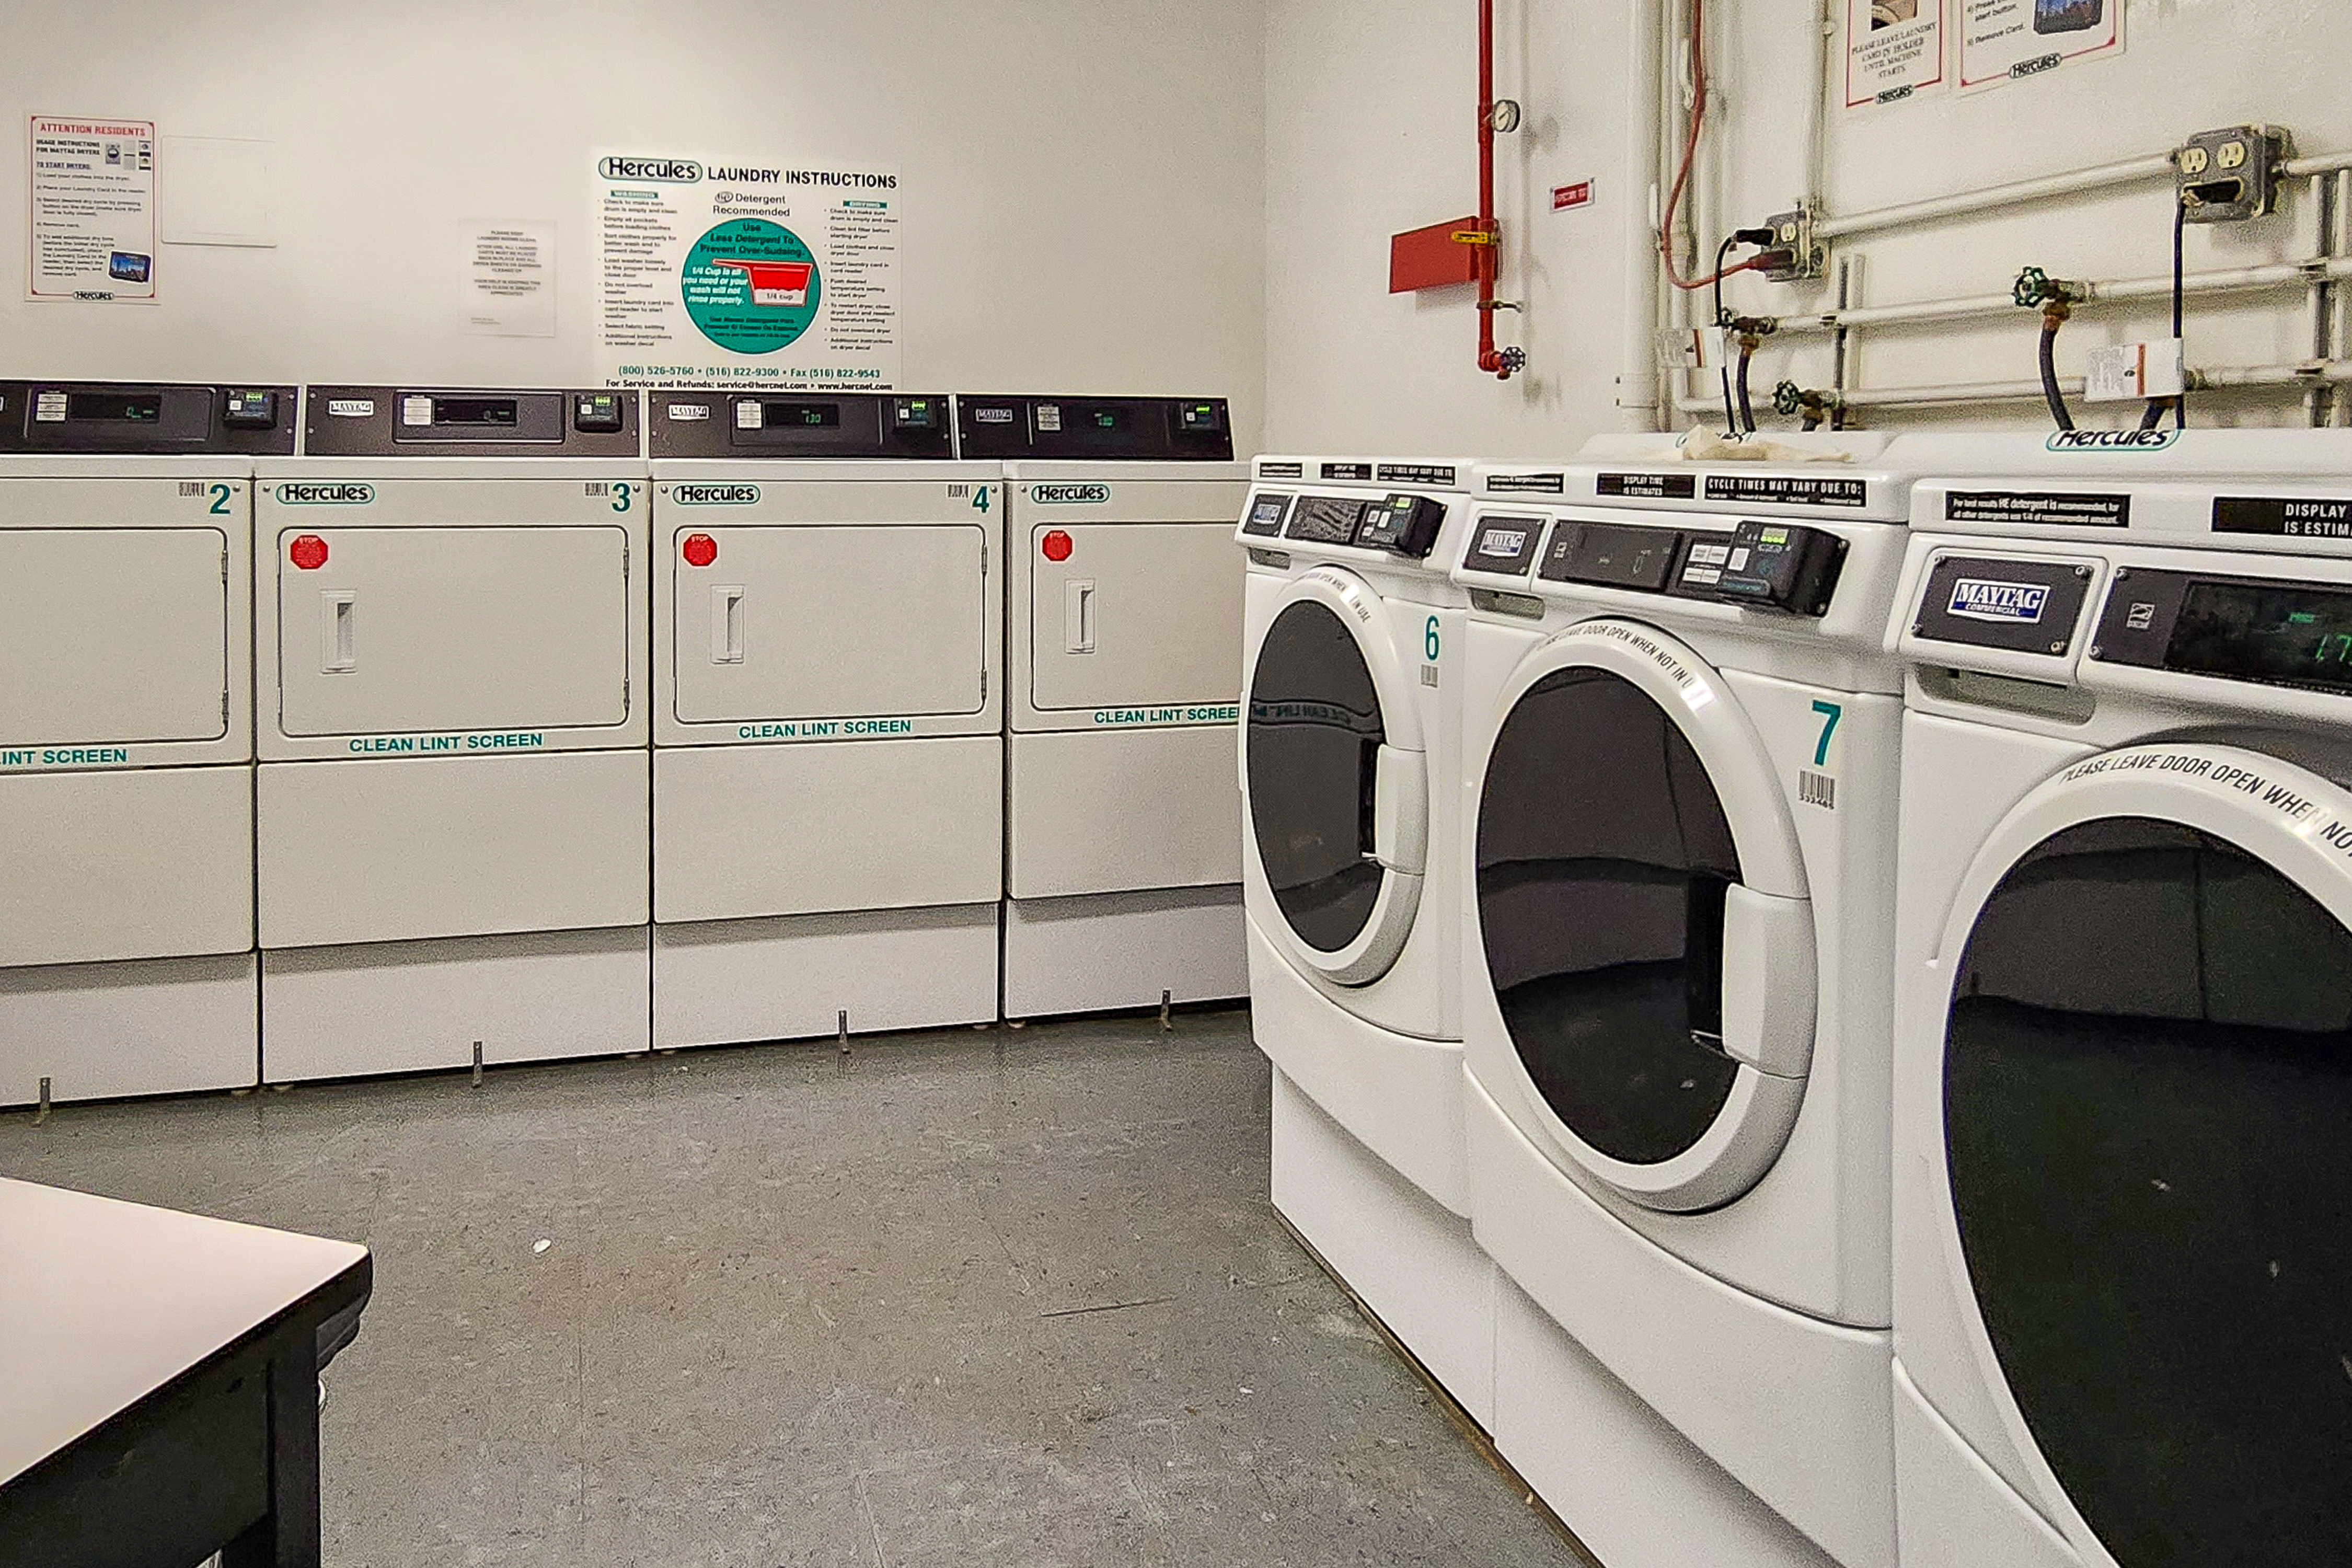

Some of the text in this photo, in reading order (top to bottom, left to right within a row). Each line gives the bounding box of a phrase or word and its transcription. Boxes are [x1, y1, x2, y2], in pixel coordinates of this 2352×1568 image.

[40, 123, 146, 136] ATTENTION RESIDENTS
[609, 157, 897, 189] Hercules LAUNDRY INSTRUCTIONS
[735, 193, 786, 204] Detergent
[713, 205, 790, 216] Recommended
[743, 223, 762, 232] Use
[710, 233, 732, 242] Less
[735, 235, 781, 245] Detergent
[700, 244, 805, 258] Prevent Over-Sudsing.
[705, 267, 721, 276] Cup
[683, 278, 697, 286] you
[709, 296, 744, 306] properly.
[619, 366, 644, 376] (800)
[647, 366, 694, 375] 526-5760
[733, 367, 779, 377] 822-9300
[790, 368, 806, 377] Fax
[837, 369, 880, 378] 822-9543
[623, 379, 655, 388] Service
[2056, 430, 2171, 446] Hercules
[1623, 476, 1664, 485] DISPLAY TIME
[1708, 478, 1735, 490] CYCLE
[1738, 479, 1766, 491] TIMES
[1769, 480, 1789, 492] MAY
[1792, 481, 1817, 493] VARY
[1820, 482, 1840, 493] DUE
[210, 483, 231, 514] 2
[285, 484, 368, 500] Hercules
[612, 482, 630, 512] 3
[681, 485, 754, 501] Hercules
[973, 485, 989, 513] 4
[1039, 485, 1104, 501] Hercules
[2010, 499, 2048, 511] detergent
[2286, 503, 2347, 518] DISPLAY
[2284, 521, 2352, 536] IS ESTIM
[1956, 584, 2042, 609] MAYTAG
[1965, 603, 2021, 616] COMMERCIAL
[1425, 615, 1439, 661] 6
[1607, 627, 1632, 642] OPEN
[1629, 635, 1661, 656] WHEN
[1655, 651, 1679, 672] NOT
[1673, 667, 1689, 683] IN
[1094, 707, 1240, 723] CLEAN LINT SCREE
[739, 720, 912, 738] CLEAN LINT SCREEN
[1812, 700, 1841, 766] 7
[349, 733, 543, 752] CLEAN LINT SCREEN
[0, 749, 127, 765] INT SCREEN
[2059, 758, 2112, 784] PLEASE
[2109, 754, 2162, 771] LEAVE
[2159, 755, 2213, 776] DOOR
[2211, 765, 2265, 795] OPEN
[2320, 821, 2352, 857] NO
